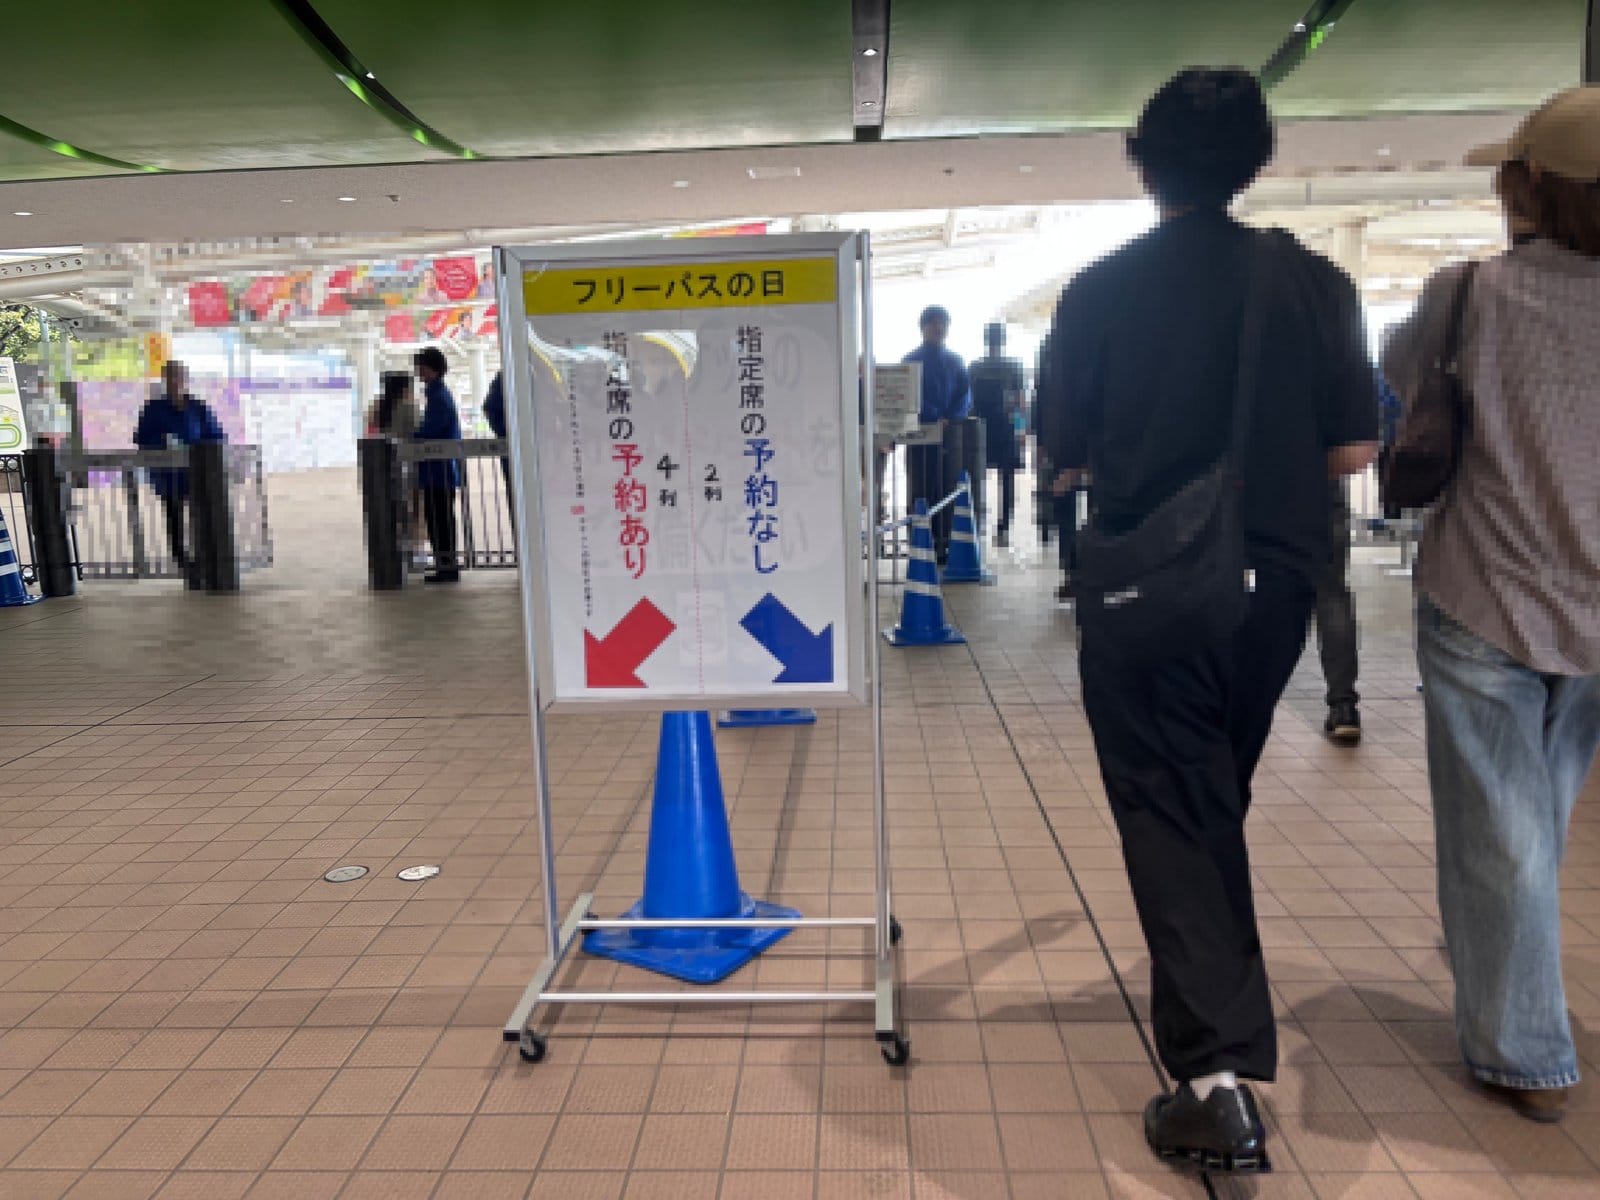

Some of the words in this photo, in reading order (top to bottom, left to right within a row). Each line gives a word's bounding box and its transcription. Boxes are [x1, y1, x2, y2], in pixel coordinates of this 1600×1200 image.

[573, 270, 784, 305] フリーパスの日
[736, 325, 779, 575] 指定席の予約なし
